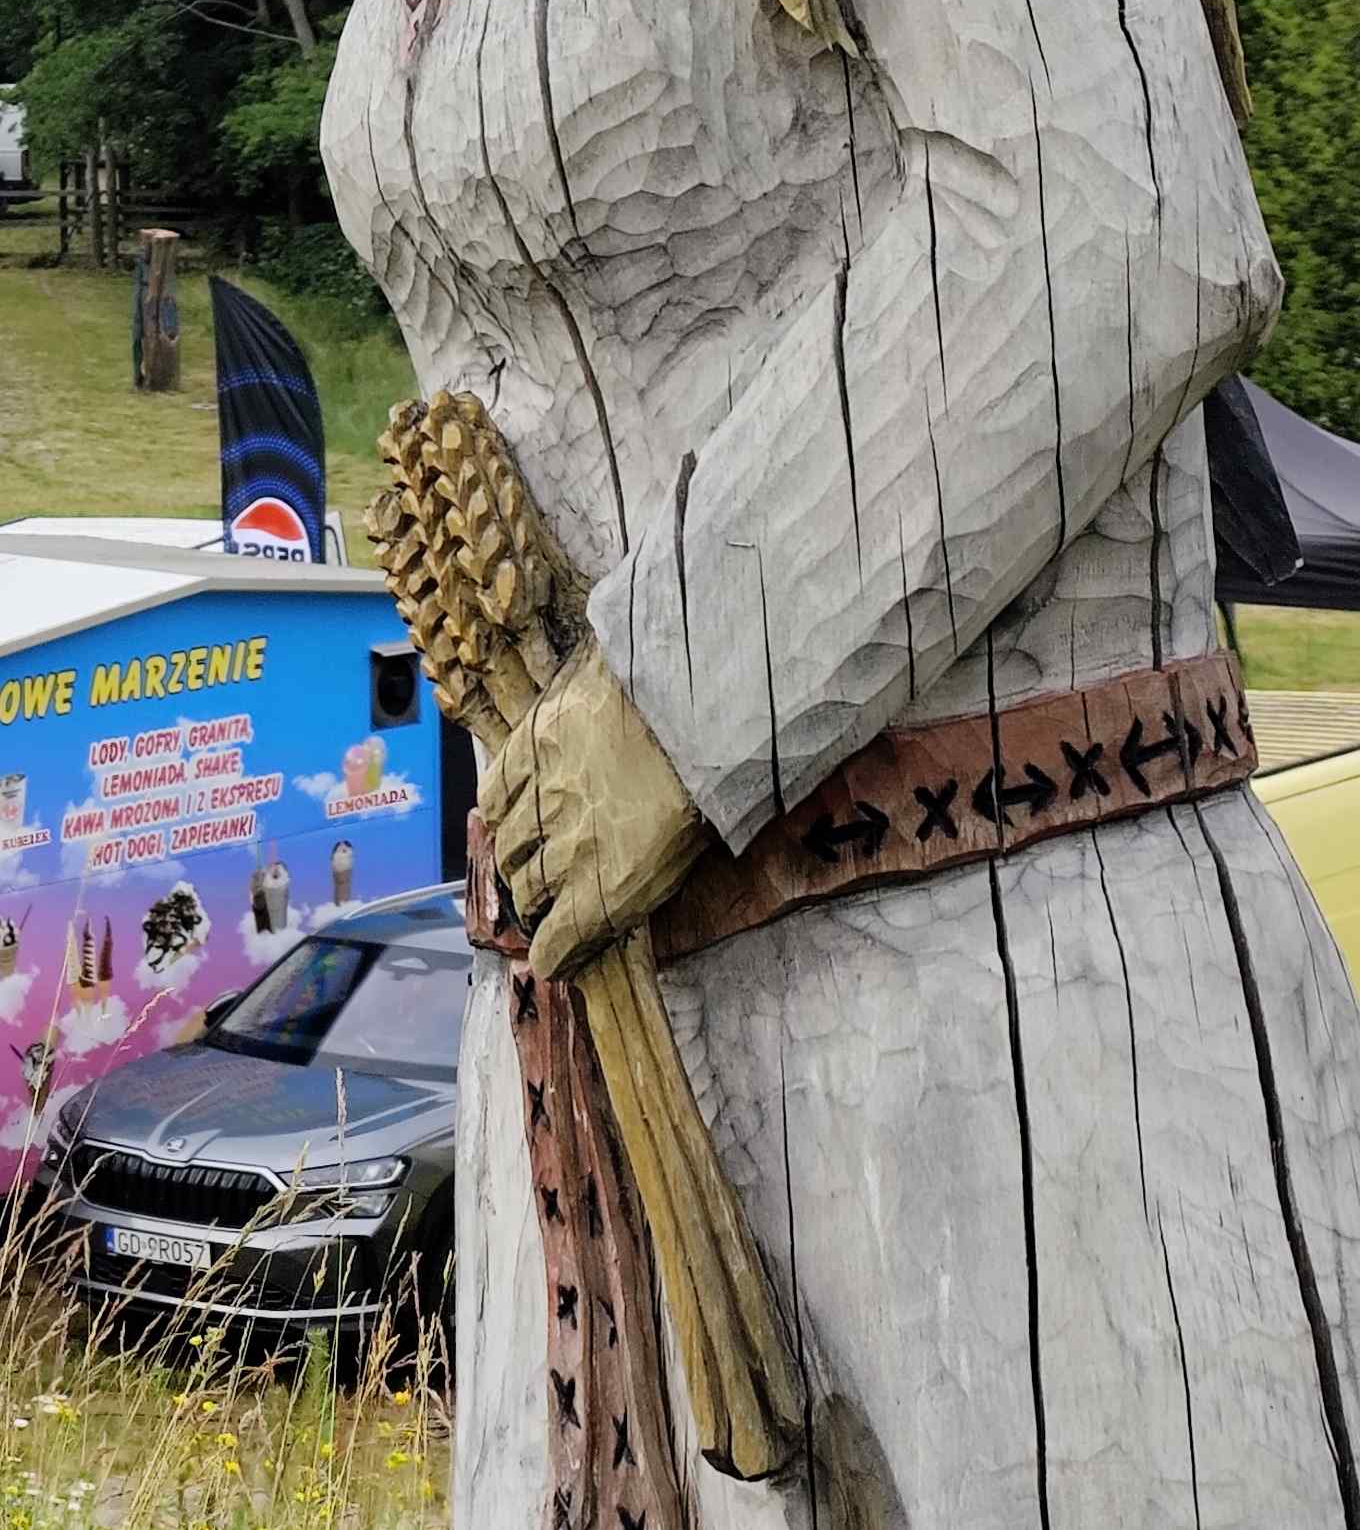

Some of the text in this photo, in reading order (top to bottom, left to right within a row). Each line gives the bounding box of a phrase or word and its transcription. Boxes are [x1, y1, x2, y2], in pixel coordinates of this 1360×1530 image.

[89, 636, 268, 707] MARZENIE
[91, 717, 252, 766] LODY, GOFRY, GRANITA,
[103, 763, 187, 798] LEMONIADA,
[328, 789, 409, 816] LEMONIADA
[63, 812, 105, 839] KAWA
[186, 793, 192, 814] I
[197, 791, 206, 812] Z
[211, 777, 281, 810] EKSPRESU
[93, 813, 257, 866] HOT DOGI, ZAPIEKANKI
[117, 1231, 141, 1255] GD
